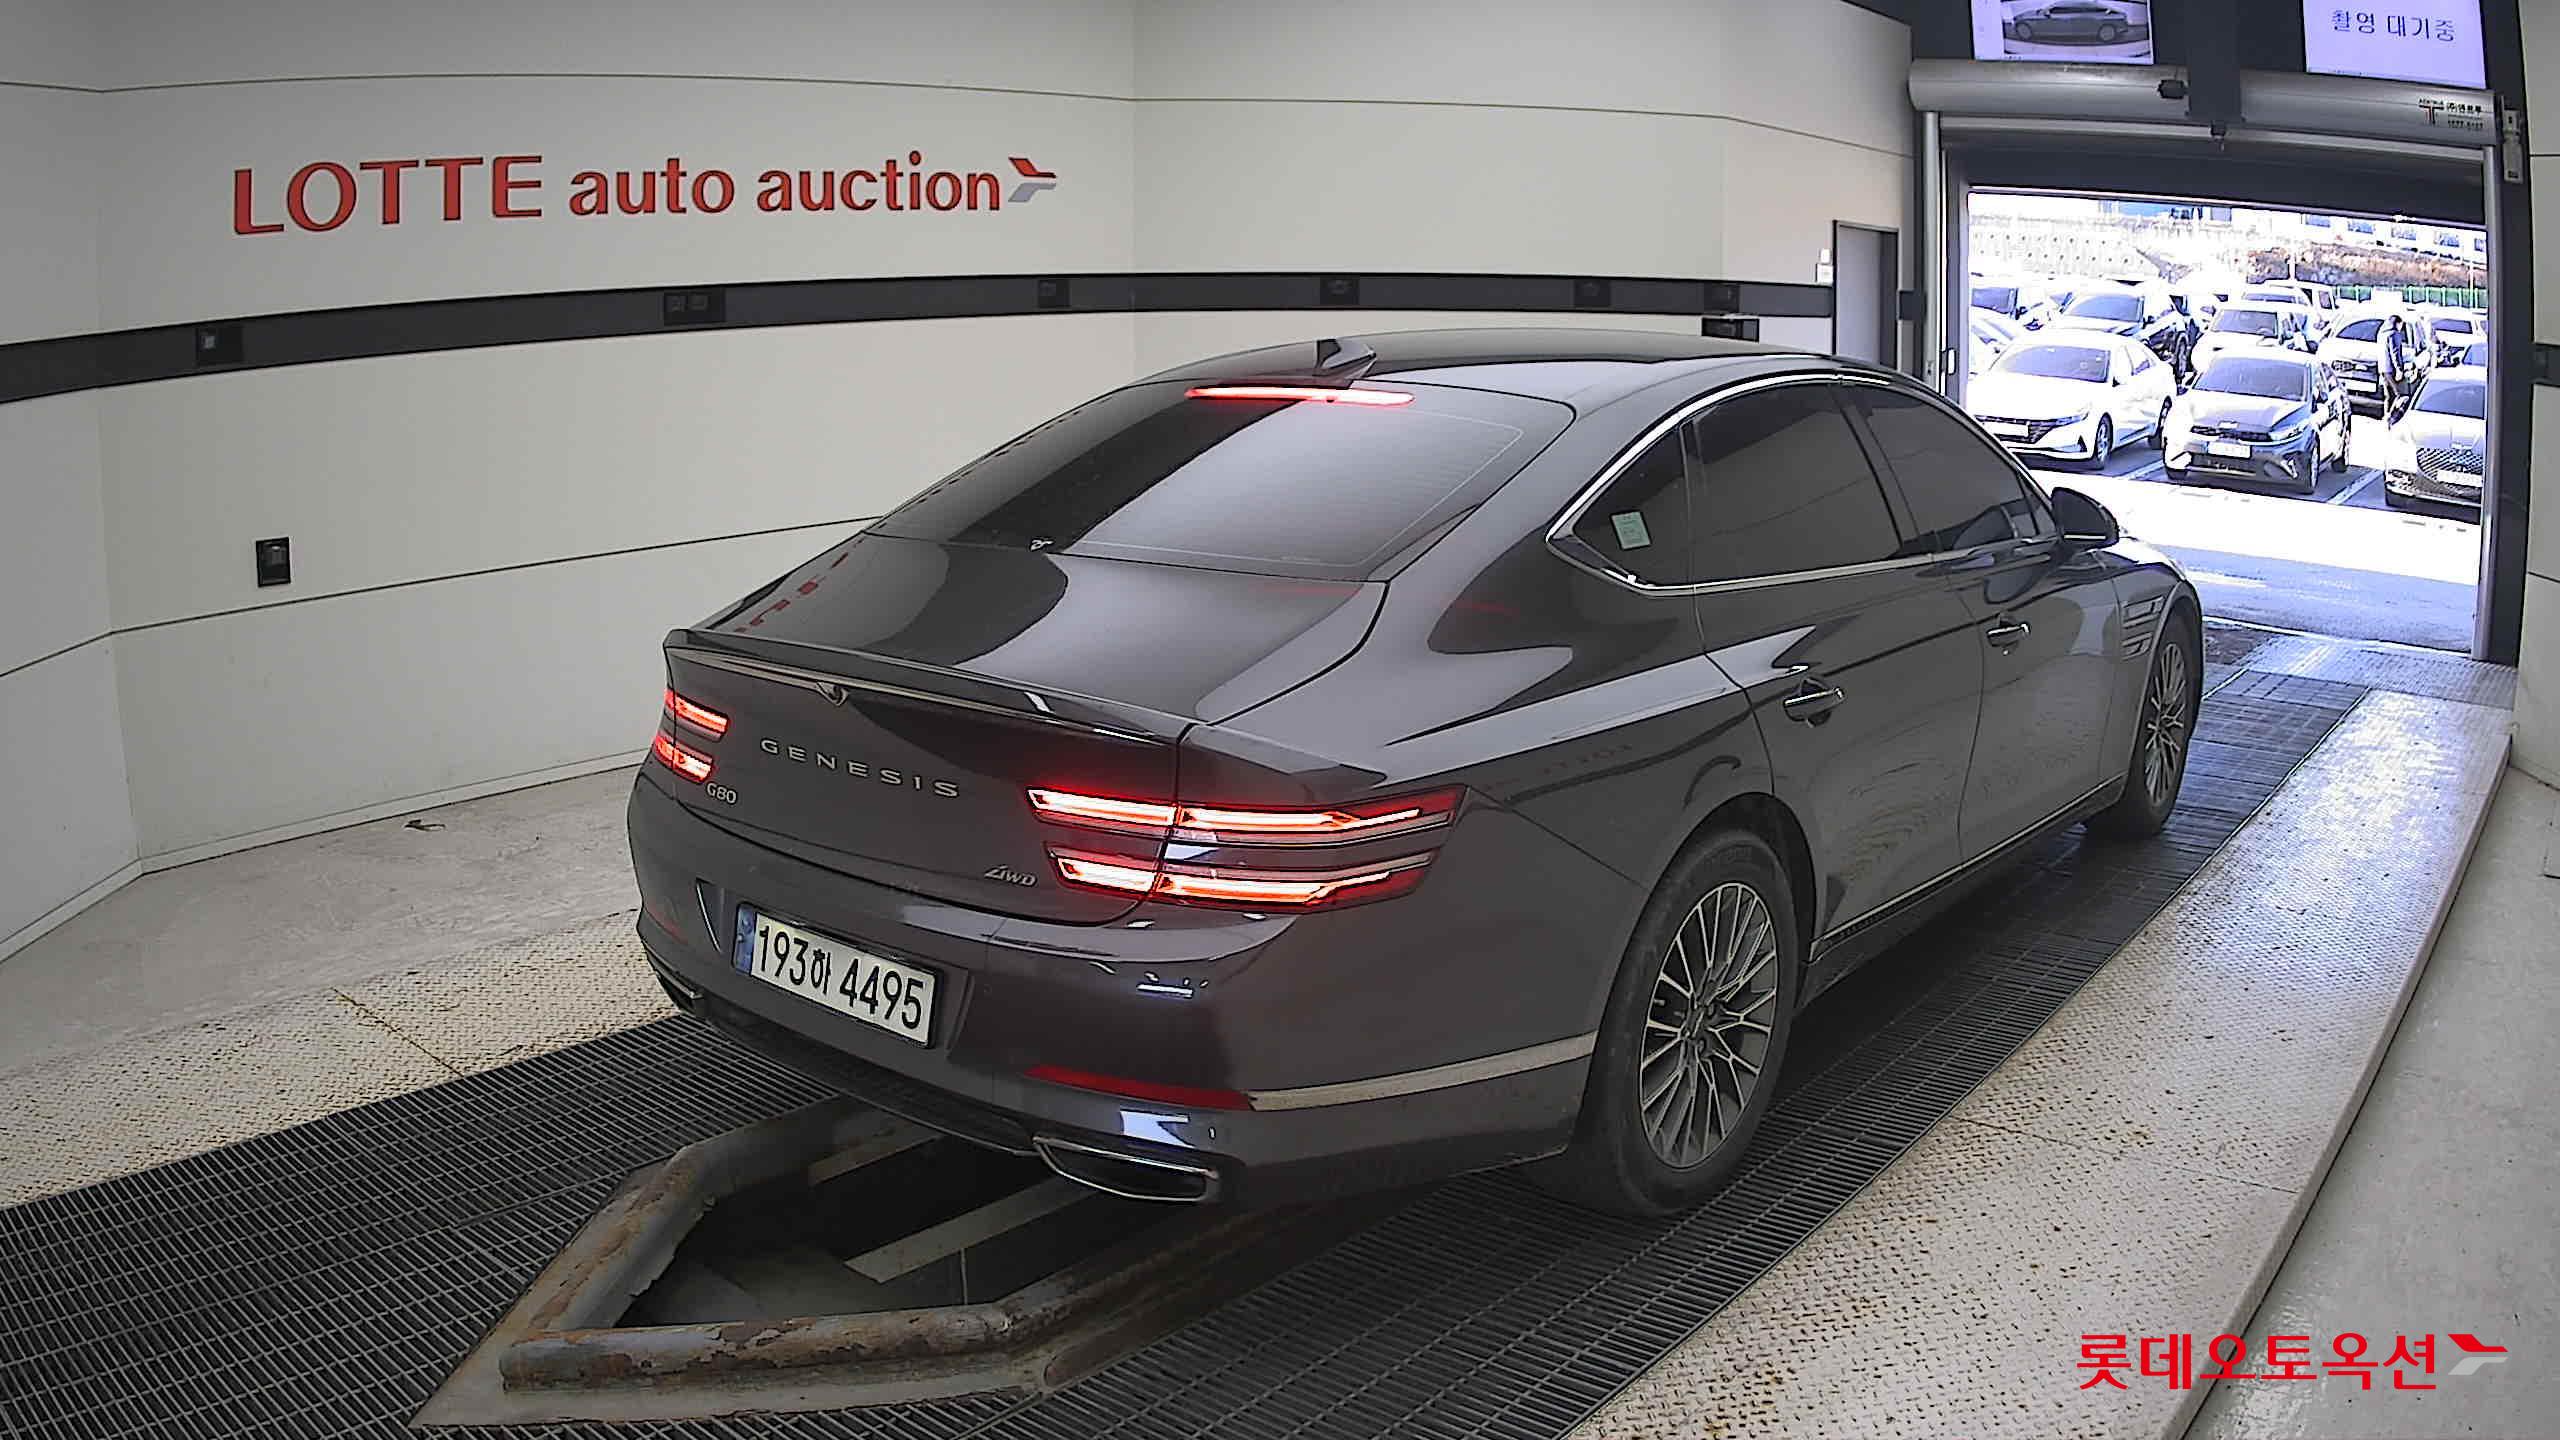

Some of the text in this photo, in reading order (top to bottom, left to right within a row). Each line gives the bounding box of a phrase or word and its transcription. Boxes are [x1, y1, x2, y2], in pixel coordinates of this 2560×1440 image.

[2387, 15, 2456, 42] 대기중
[234, 151, 1001, 235] LOTTE auto auction
[706, 783, 738, 805] G80
[760, 739, 960, 798] GENESIS
[759, 925, 924, 1030] 193하 4495
